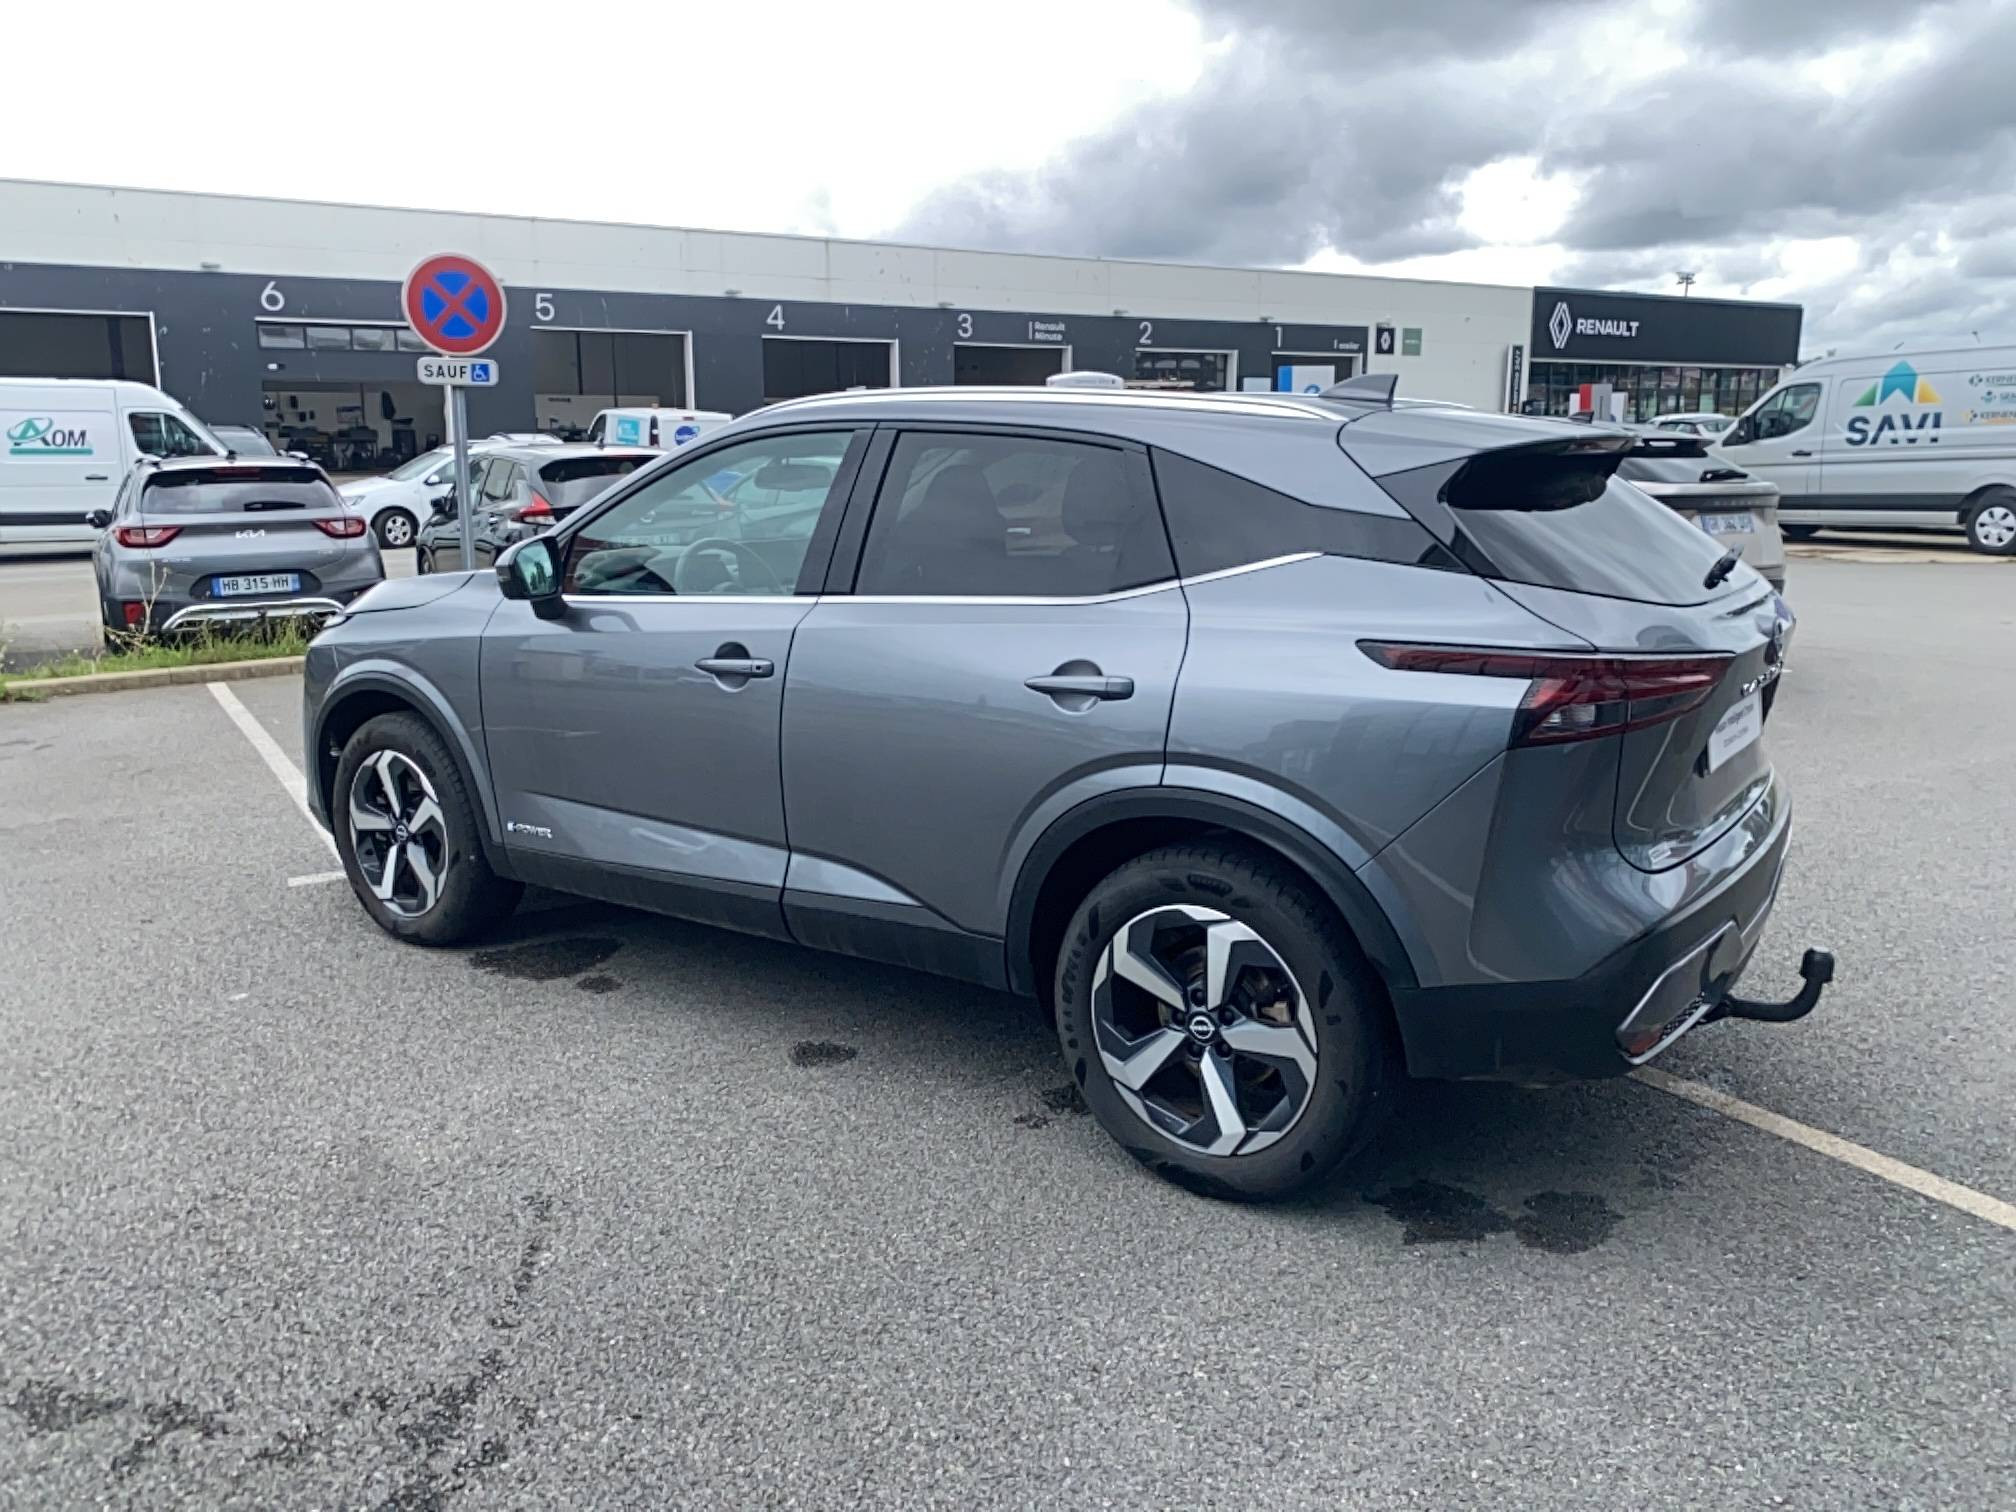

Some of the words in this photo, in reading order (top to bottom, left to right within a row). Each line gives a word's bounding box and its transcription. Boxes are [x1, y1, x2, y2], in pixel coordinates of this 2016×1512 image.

[260, 281, 285, 311] 6
[535, 293, 555, 321] 5
[766, 304, 785, 331] 4
[957, 313, 973, 338] 3
[1576, 317, 1640, 337] RENAULT
[1138, 321, 1153, 344] 2
[1275, 326, 1282, 348] 1
[423, 364, 469, 380] SAUF
[1845, 412, 1943, 446] SAVI
[222, 579, 239, 591] HB
[243, 577, 269, 590] 315
